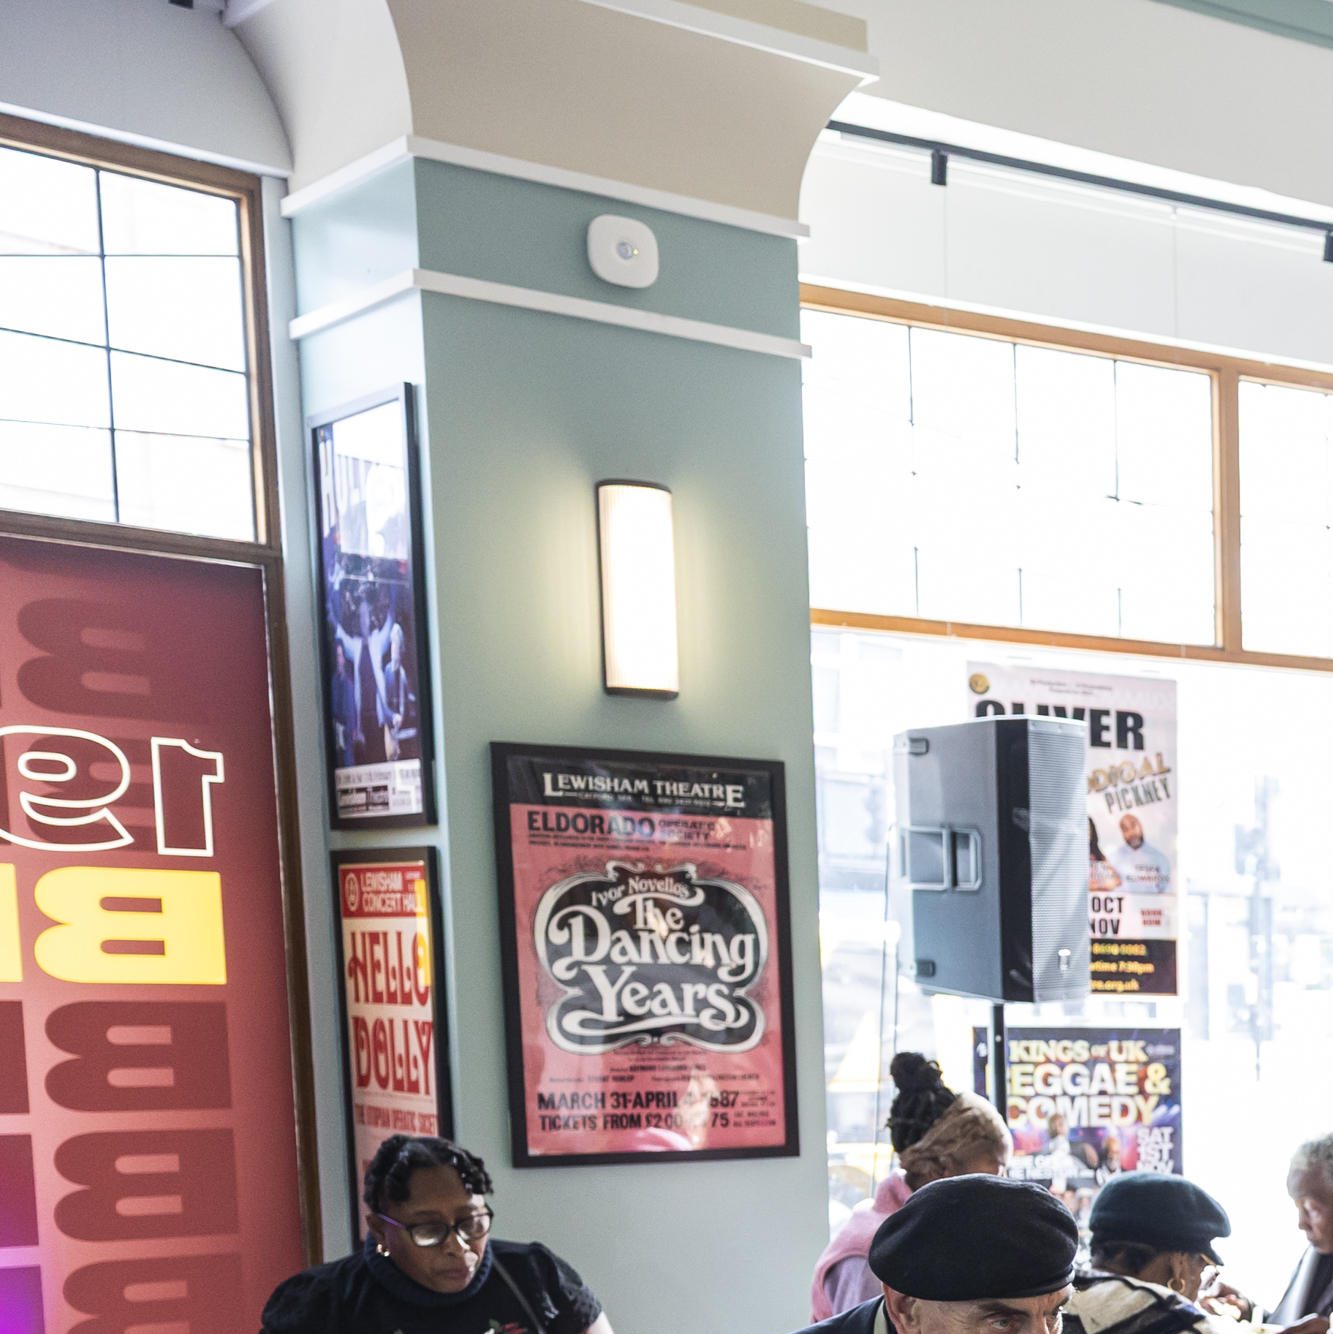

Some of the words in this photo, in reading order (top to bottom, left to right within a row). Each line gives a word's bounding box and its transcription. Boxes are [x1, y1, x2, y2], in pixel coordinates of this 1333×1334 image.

[543, 772, 649, 797] LEWISHAM
[653, 781, 746, 808] THEATRE
[527, 810, 656, 838] ELDORADO
[360, 872, 403, 892] LEWISHAM
[591, 885, 625, 907] Ivor
[618, 888, 695, 931] The
[1092, 896, 1125, 914] OCT
[548, 904, 756, 983] Dancing
[348, 930, 432, 1007] HELLO
[562, 964, 749, 1036] Years
[351, 1015, 434, 1096] DOLLY
[1008, 1039, 1090, 1063] KINGS
[1108, 1040, 1149, 1063] UK
[986, 1062, 1139, 1096] EGGAE
[1143, 1063, 1171, 1095] &
[537, 1092, 605, 1111] MARCH
[1006, 1095, 1159, 1128] COMEDY
[539, 1113, 598, 1132] TICKETS
[602, 1113, 642, 1130] FROM
